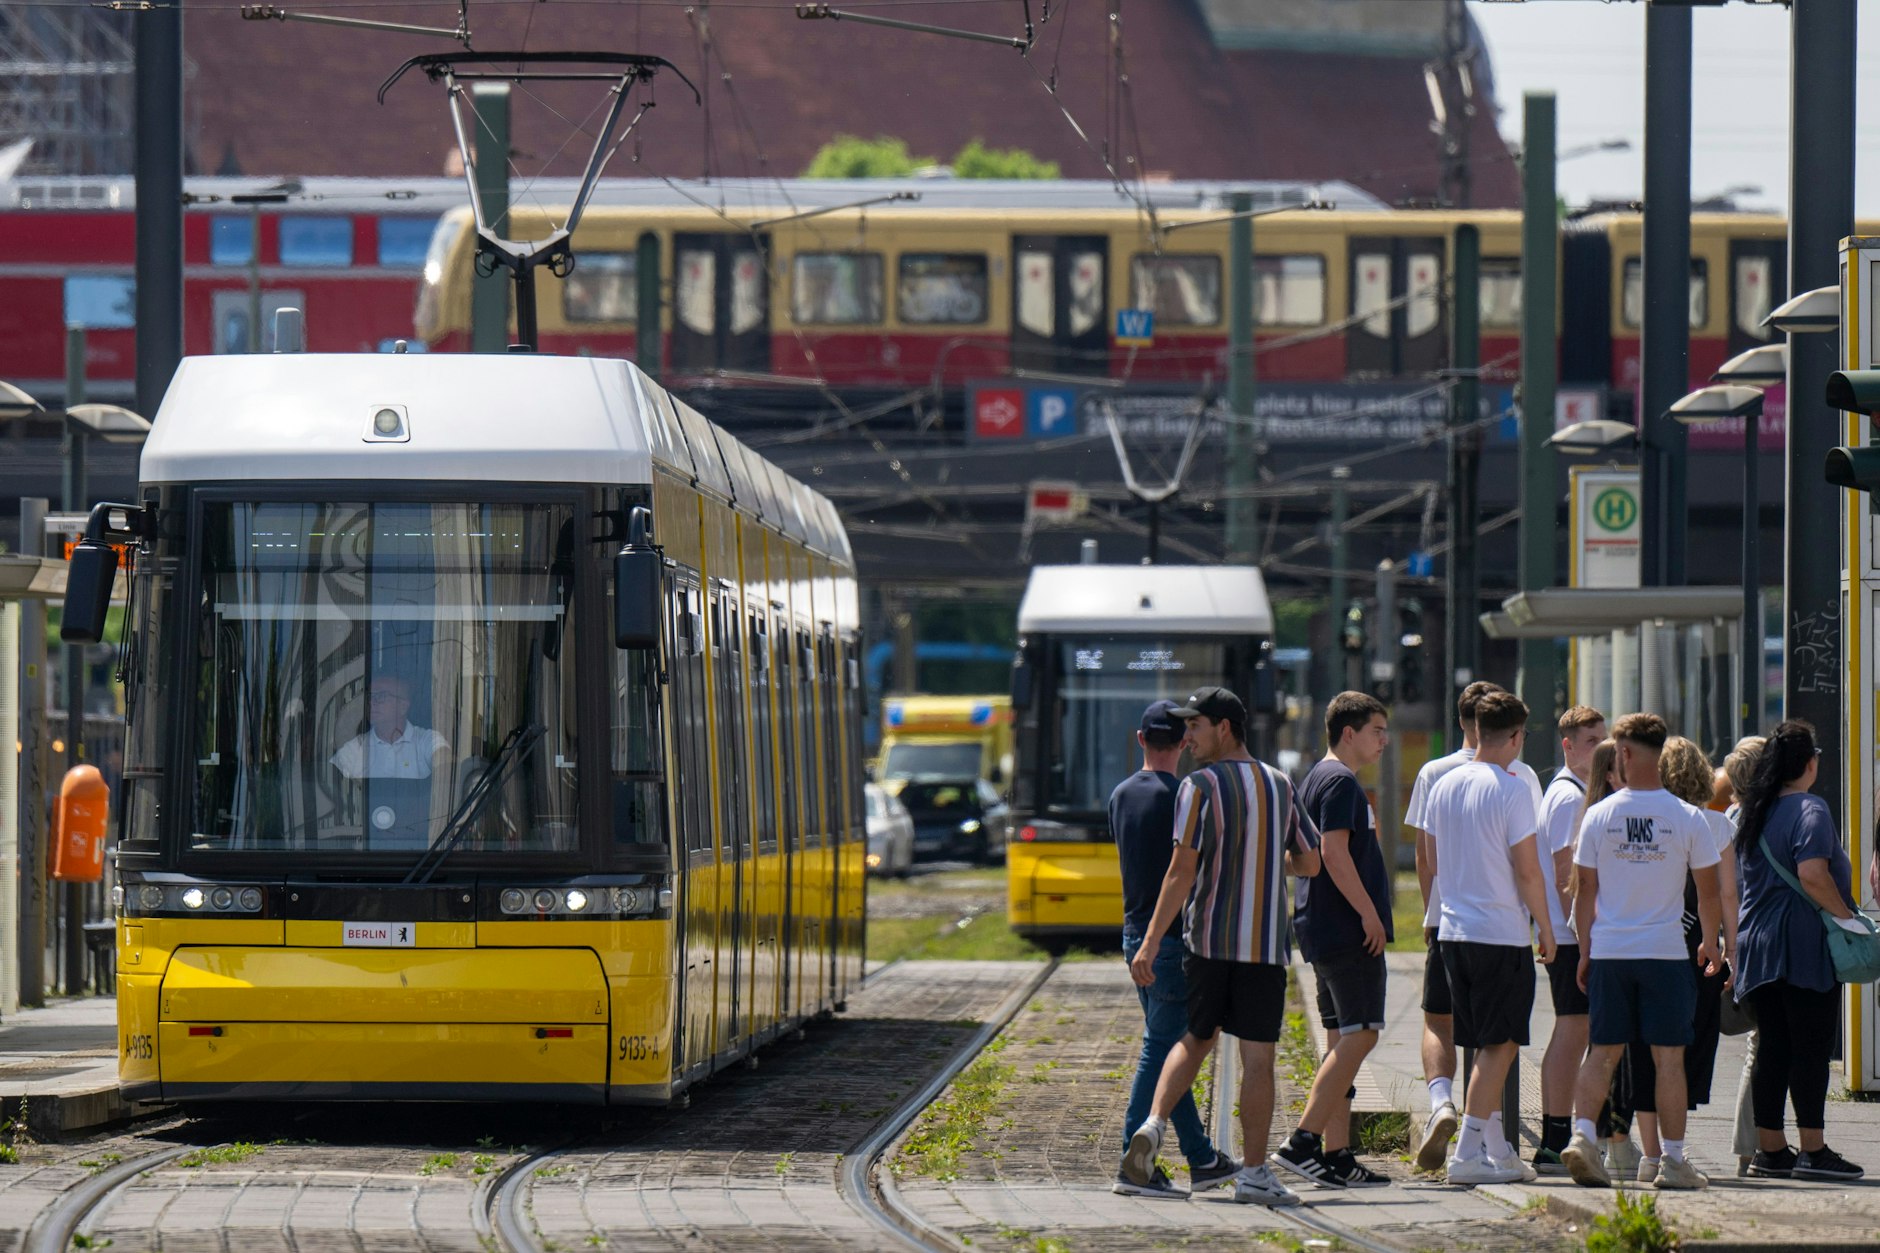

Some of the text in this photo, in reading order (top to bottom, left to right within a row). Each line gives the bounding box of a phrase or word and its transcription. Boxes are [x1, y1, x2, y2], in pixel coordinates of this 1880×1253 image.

[1122, 311, 1149, 336] W
[1040, 395, 1067, 430] P
[1606, 498, 1626, 522] H
[1626, 817, 1654, 843] VANS
[348, 929, 386, 939] BERLIN
